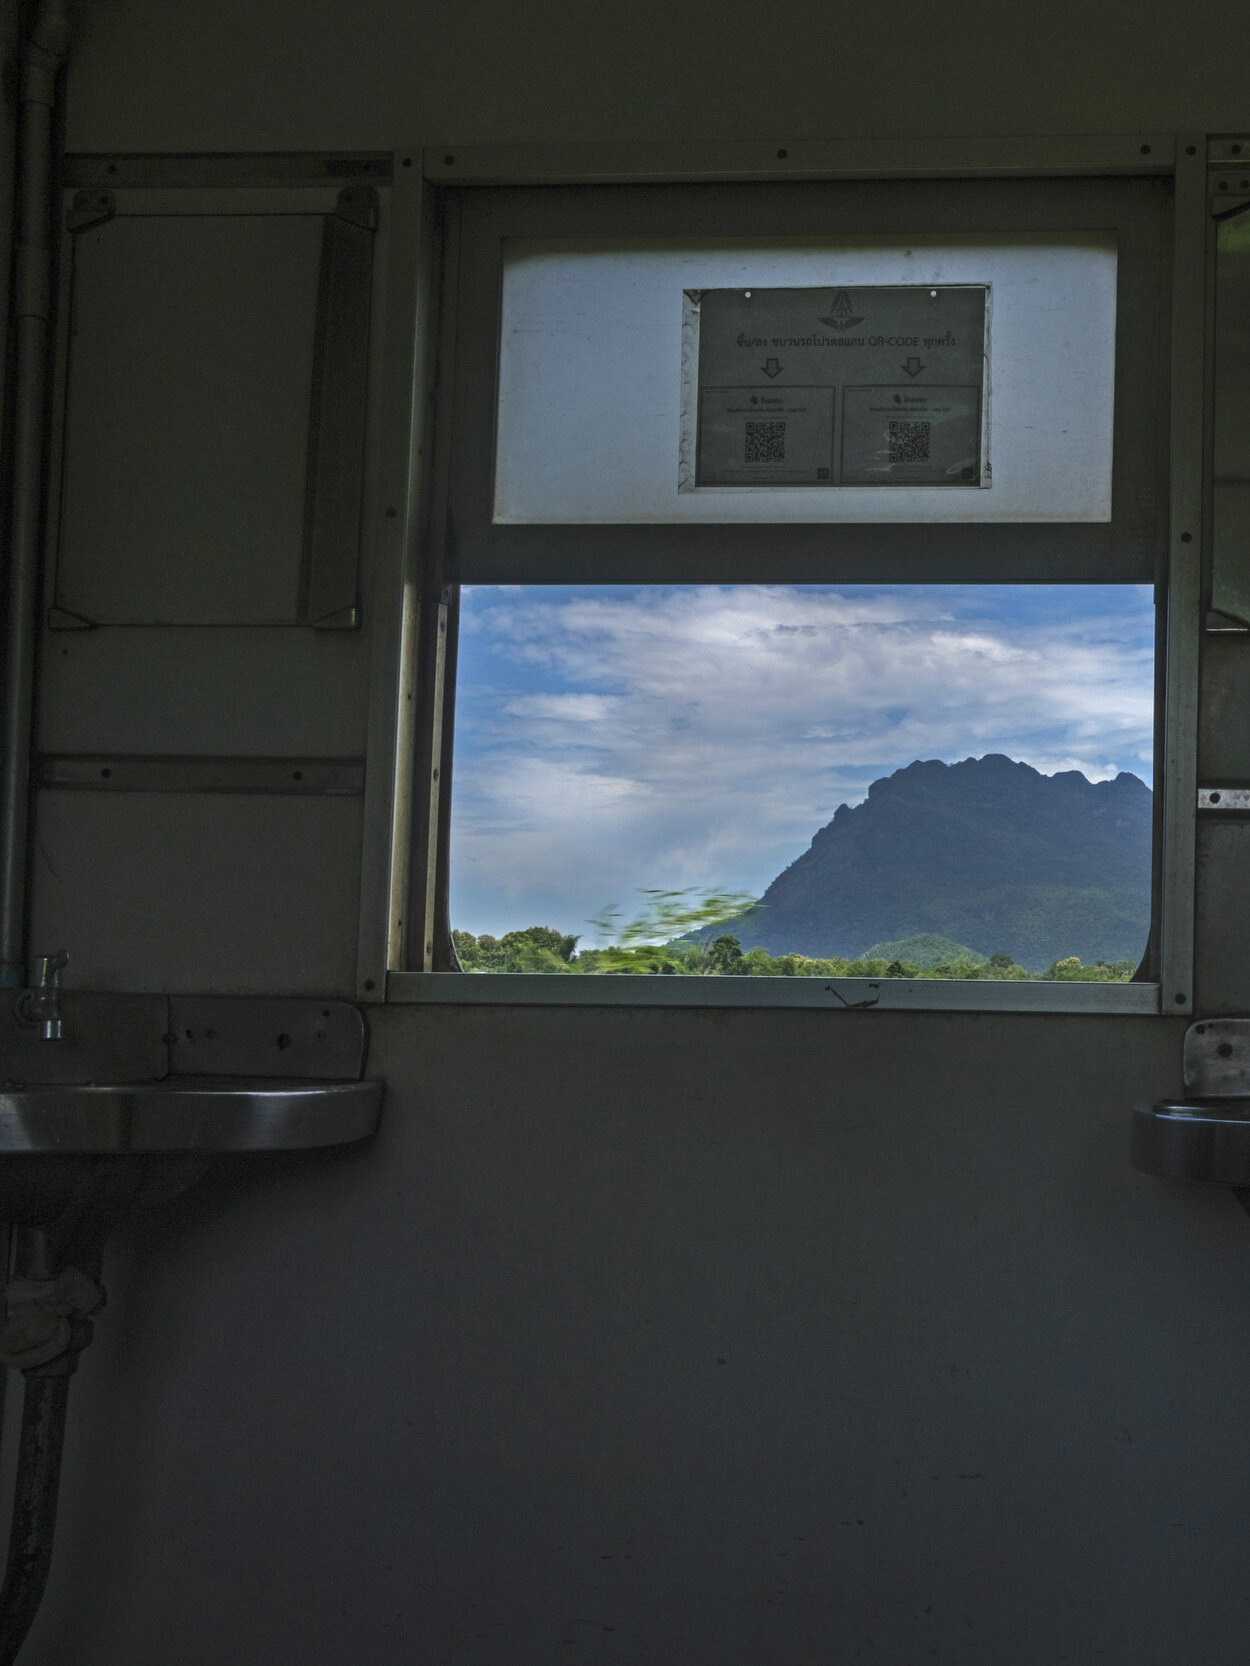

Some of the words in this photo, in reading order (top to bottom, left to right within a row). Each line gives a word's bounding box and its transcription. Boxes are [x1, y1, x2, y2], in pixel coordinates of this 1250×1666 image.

[868, 336, 920, 347] QR-CODE
[923, 330, 956, 349] ทุกครั้ง
